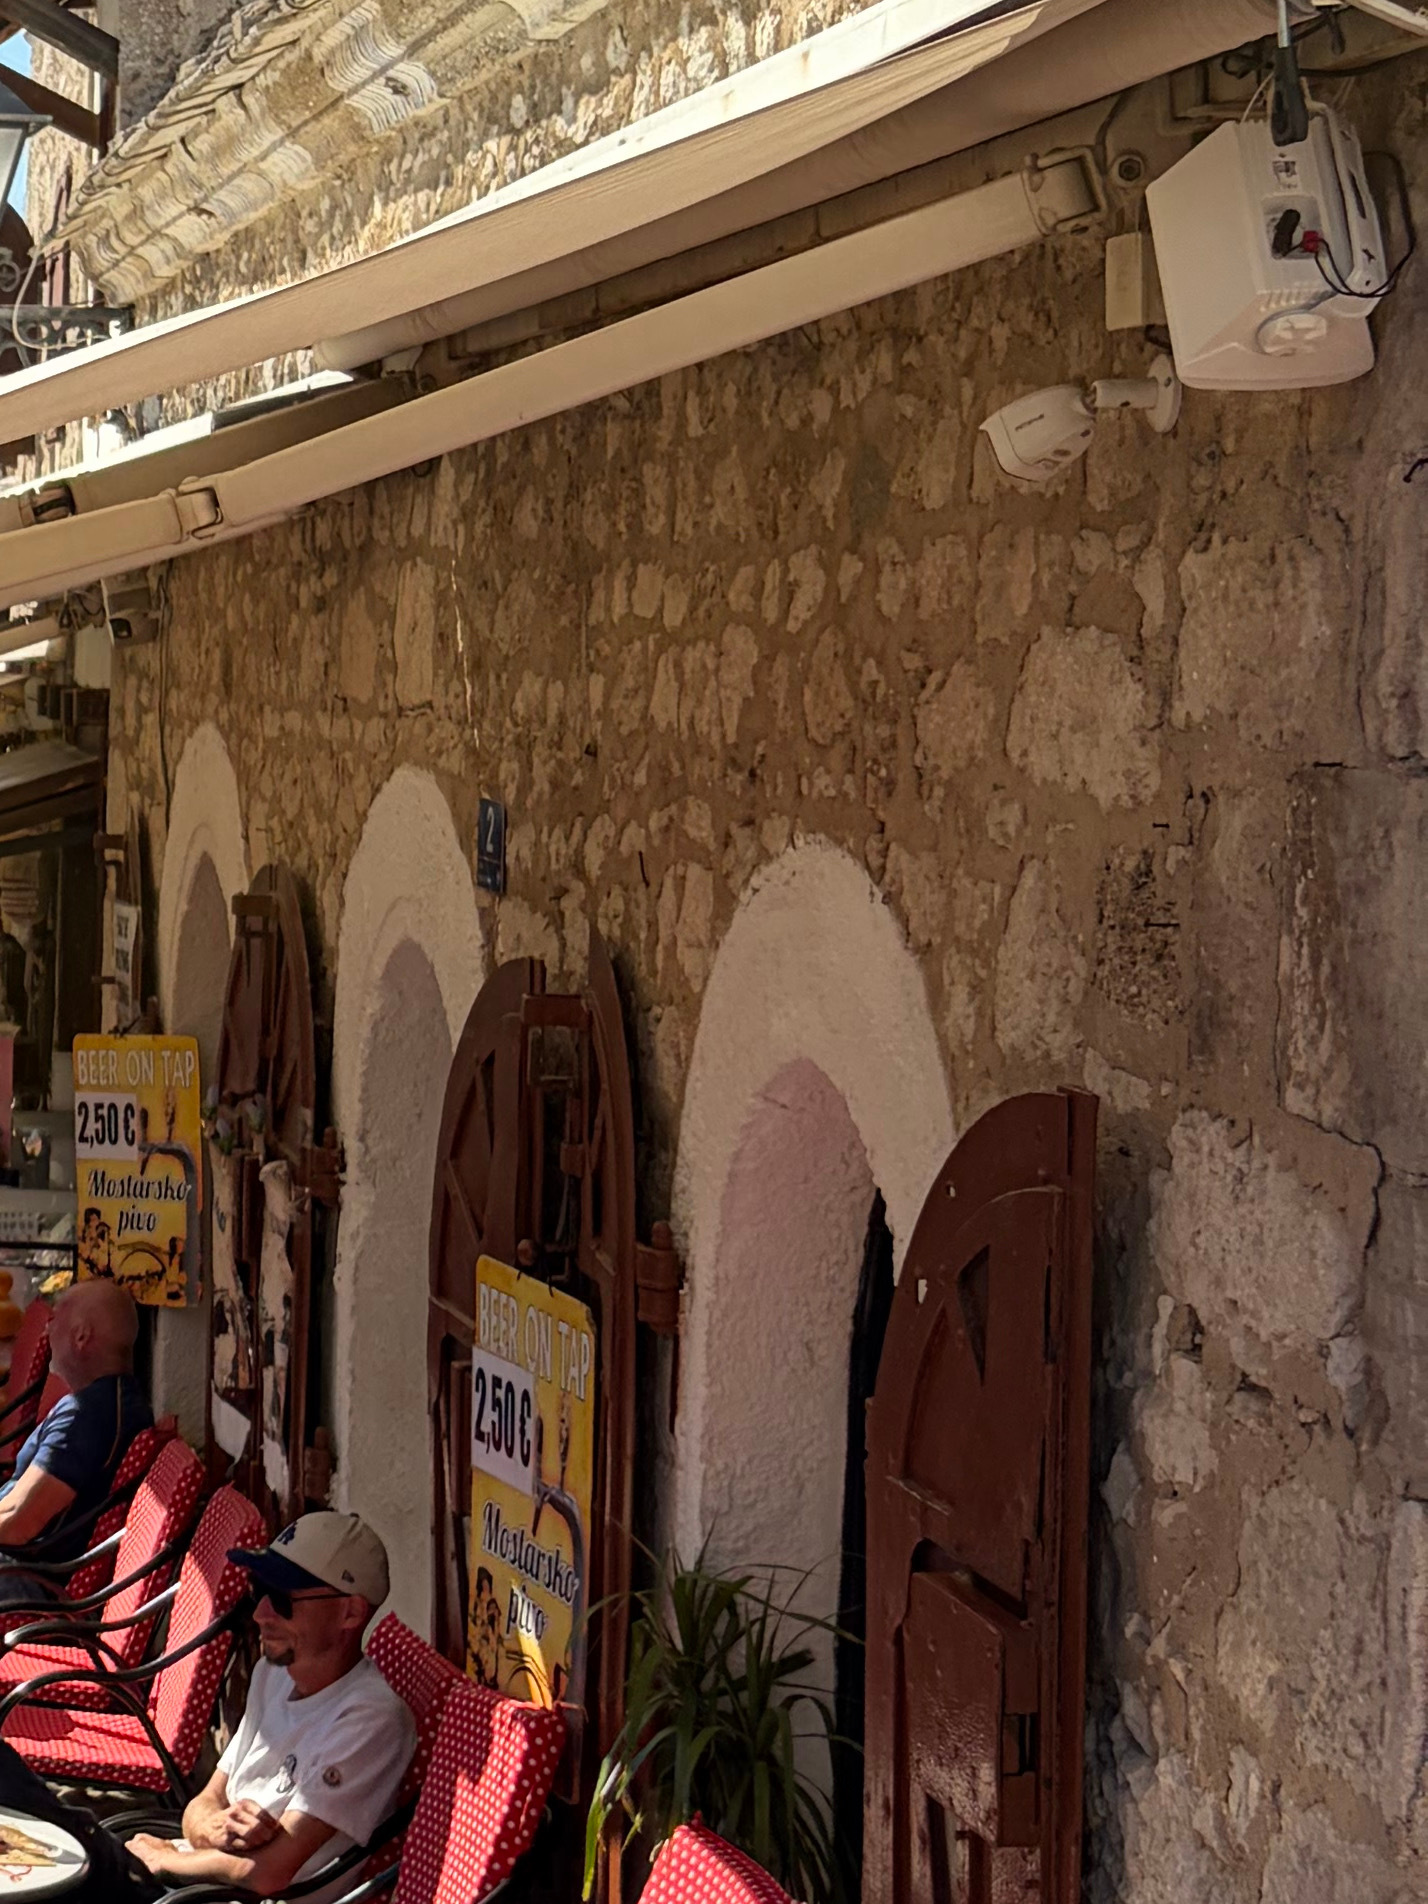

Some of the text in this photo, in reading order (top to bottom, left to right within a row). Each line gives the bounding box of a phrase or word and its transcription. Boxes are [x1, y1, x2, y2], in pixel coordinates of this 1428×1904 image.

[486, 806, 495, 853] 2
[77, 1050, 195, 1089] BEER ON TAP
[77, 1101, 136, 1148] 2,50 €
[87, 1168, 192, 1202] Mostarsko
[117, 1204, 158, 1238] pivo
[479, 1283, 591, 1402] BEER ON TAP
[475, 1366, 532, 1468] 2,50 €
[482, 1499, 580, 1606] Mostarsko
[505, 1583, 549, 1644] pivo
